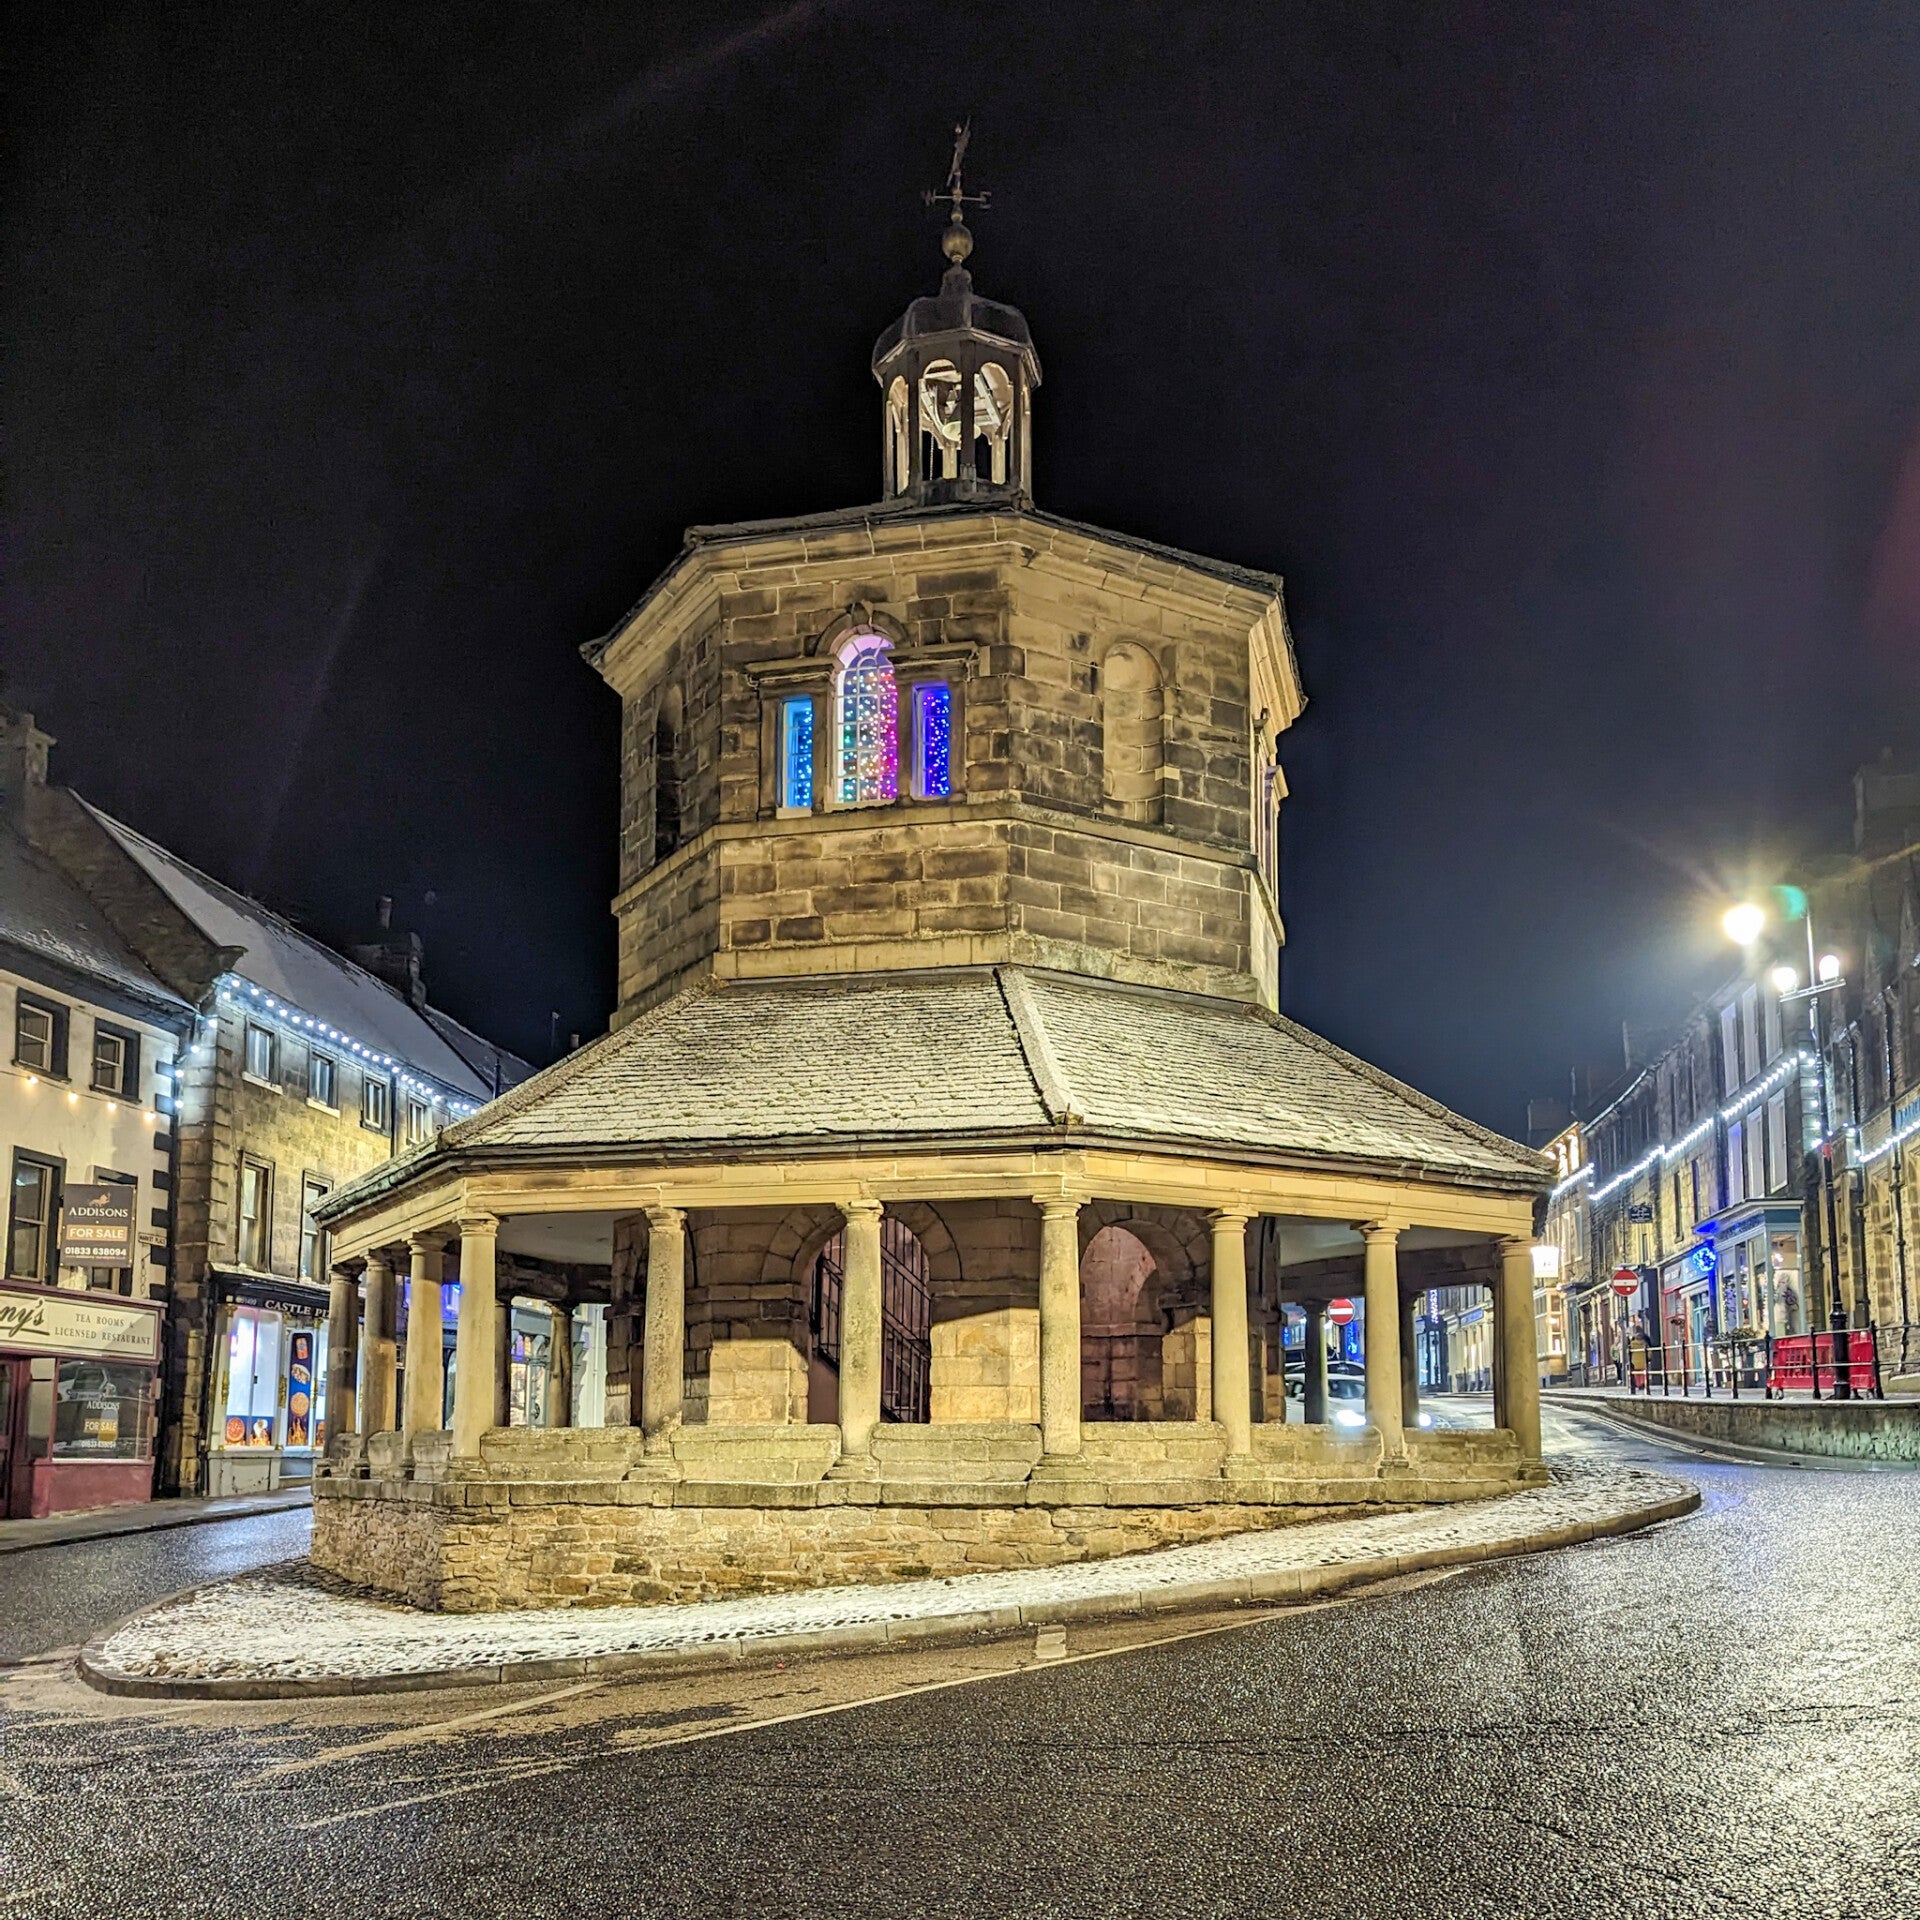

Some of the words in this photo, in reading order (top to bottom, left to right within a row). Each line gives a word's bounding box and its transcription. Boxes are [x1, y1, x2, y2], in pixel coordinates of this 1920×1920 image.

[69, 1207, 128, 1218] ADDISONS
[70, 1228, 93, 1238] FOR
[96, 1229, 124, 1239] SALE
[65, 1247, 91, 1255] 01833
[92, 1247, 127, 1256] 638094
[264, 1300, 312, 1316] CASTLE
[75, 1313, 91, 1324] TEA
[96, 1316, 125, 1328] ROOMS
[55, 1327, 97, 1340] LICENSED
[101, 1332, 151, 1346] RESTAURANT
[84, 1421, 99, 1431] FOR
[100, 1421, 117, 1431] SALE
